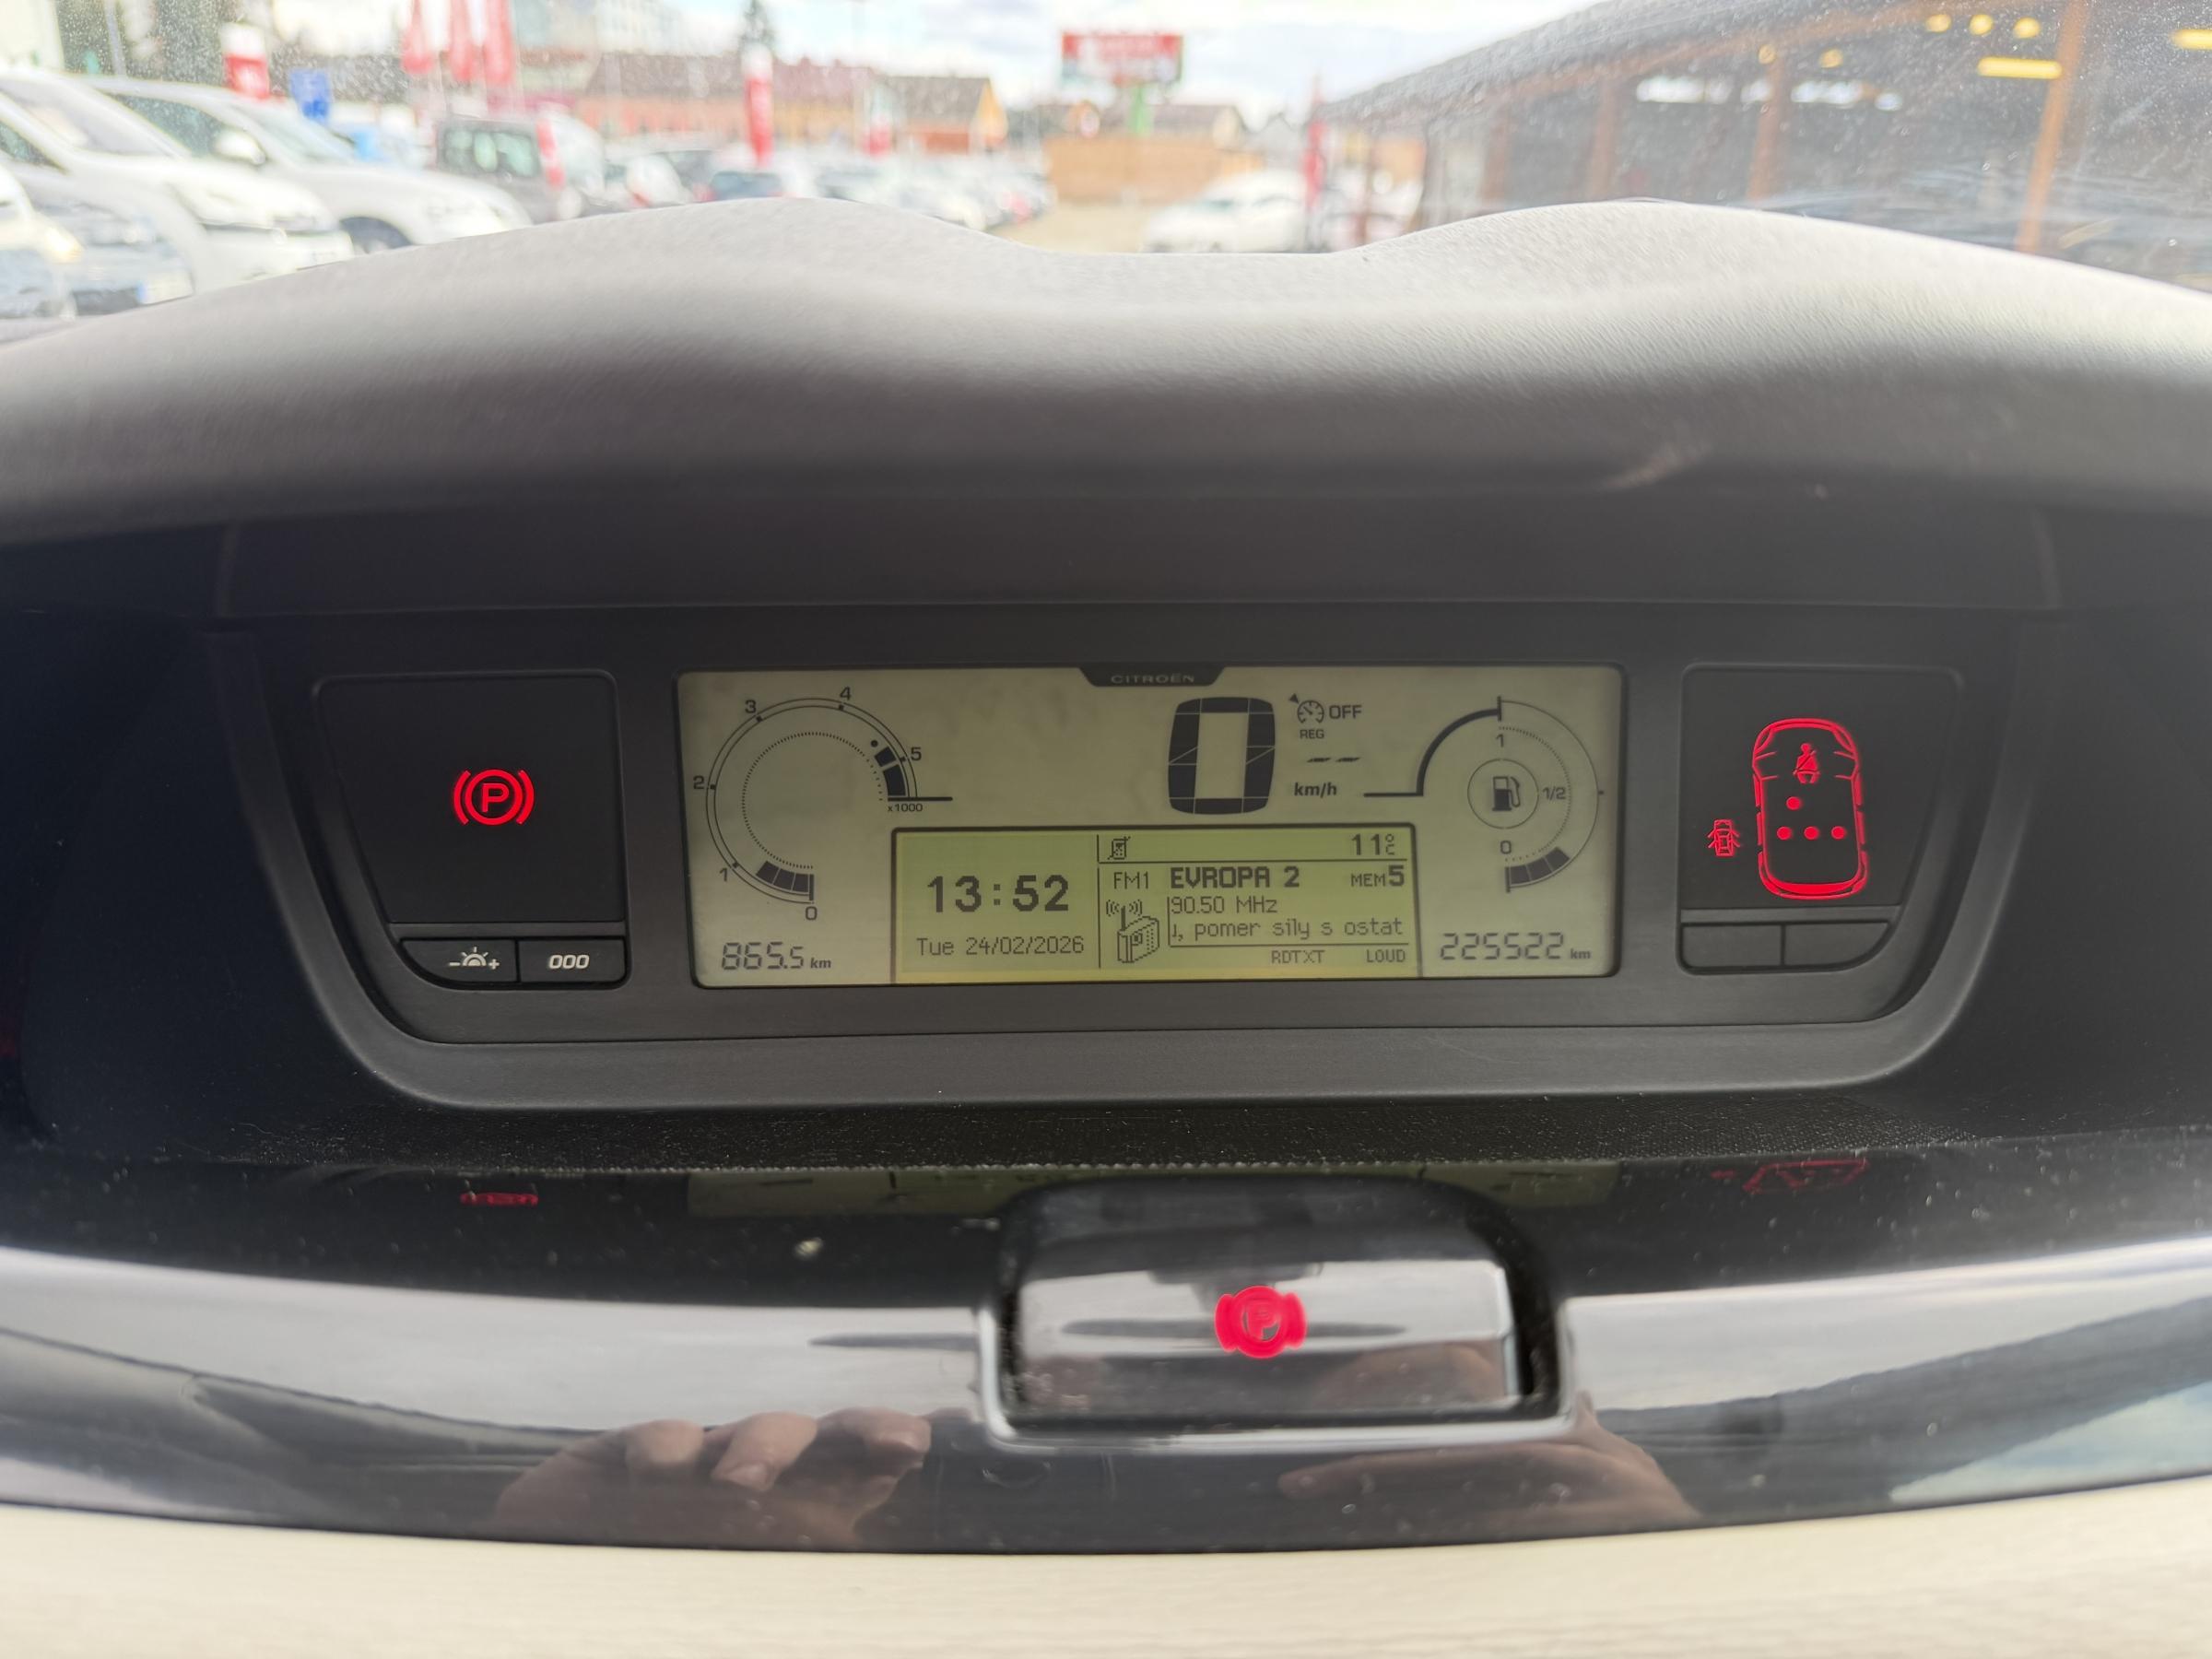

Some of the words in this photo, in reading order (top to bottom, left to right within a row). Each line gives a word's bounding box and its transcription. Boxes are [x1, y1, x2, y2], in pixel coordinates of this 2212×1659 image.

[1111, 673, 1195, 685] CITROËN
[840, 687, 852, 700] 4
[745, 700, 757, 713] 3
[1328, 704, 1362, 719] OFF
[1299, 729, 1325, 739] REG
[1496, 734, 1504, 747] 1
[910, 747, 922, 760] 5
[1168, 697, 1276, 817] 0
[693, 775, 705, 790] 2
[1293, 782, 1337, 798] km/h
[1542, 786, 1567, 800] 1/2
[888, 803, 924, 813] x1000
[1500, 840, 1512, 855] 0
[720, 868, 729, 882] 1
[1113, 871, 1149, 889] FM1
[1170, 865, 1271, 888] EVROPA
[1284, 865, 1300, 888] 2
[927, 874, 1069, 912] 13:52
[1171, 895, 1225, 914] 90.50
[1236, 895, 1278, 913] MHz
[805, 906, 818, 922] 0
[1194, 923, 1261, 942] pomer
[1272, 917, 1310, 940] sily
[1321, 922, 1334, 935] s
[1344, 917, 1404, 935] ostat
[916, 936, 954, 956] Tue
[966, 935, 1085, 956] 24/02/2026
[1440, 933, 1564, 960] 225522
[1570, 947, 1592, 960] km
[722, 942, 805, 970] 865.5
[809, 957, 832, 969] km
[1271, 949, 1325, 964] RDTXT
[1366, 948, 1406, 963] LOUD
